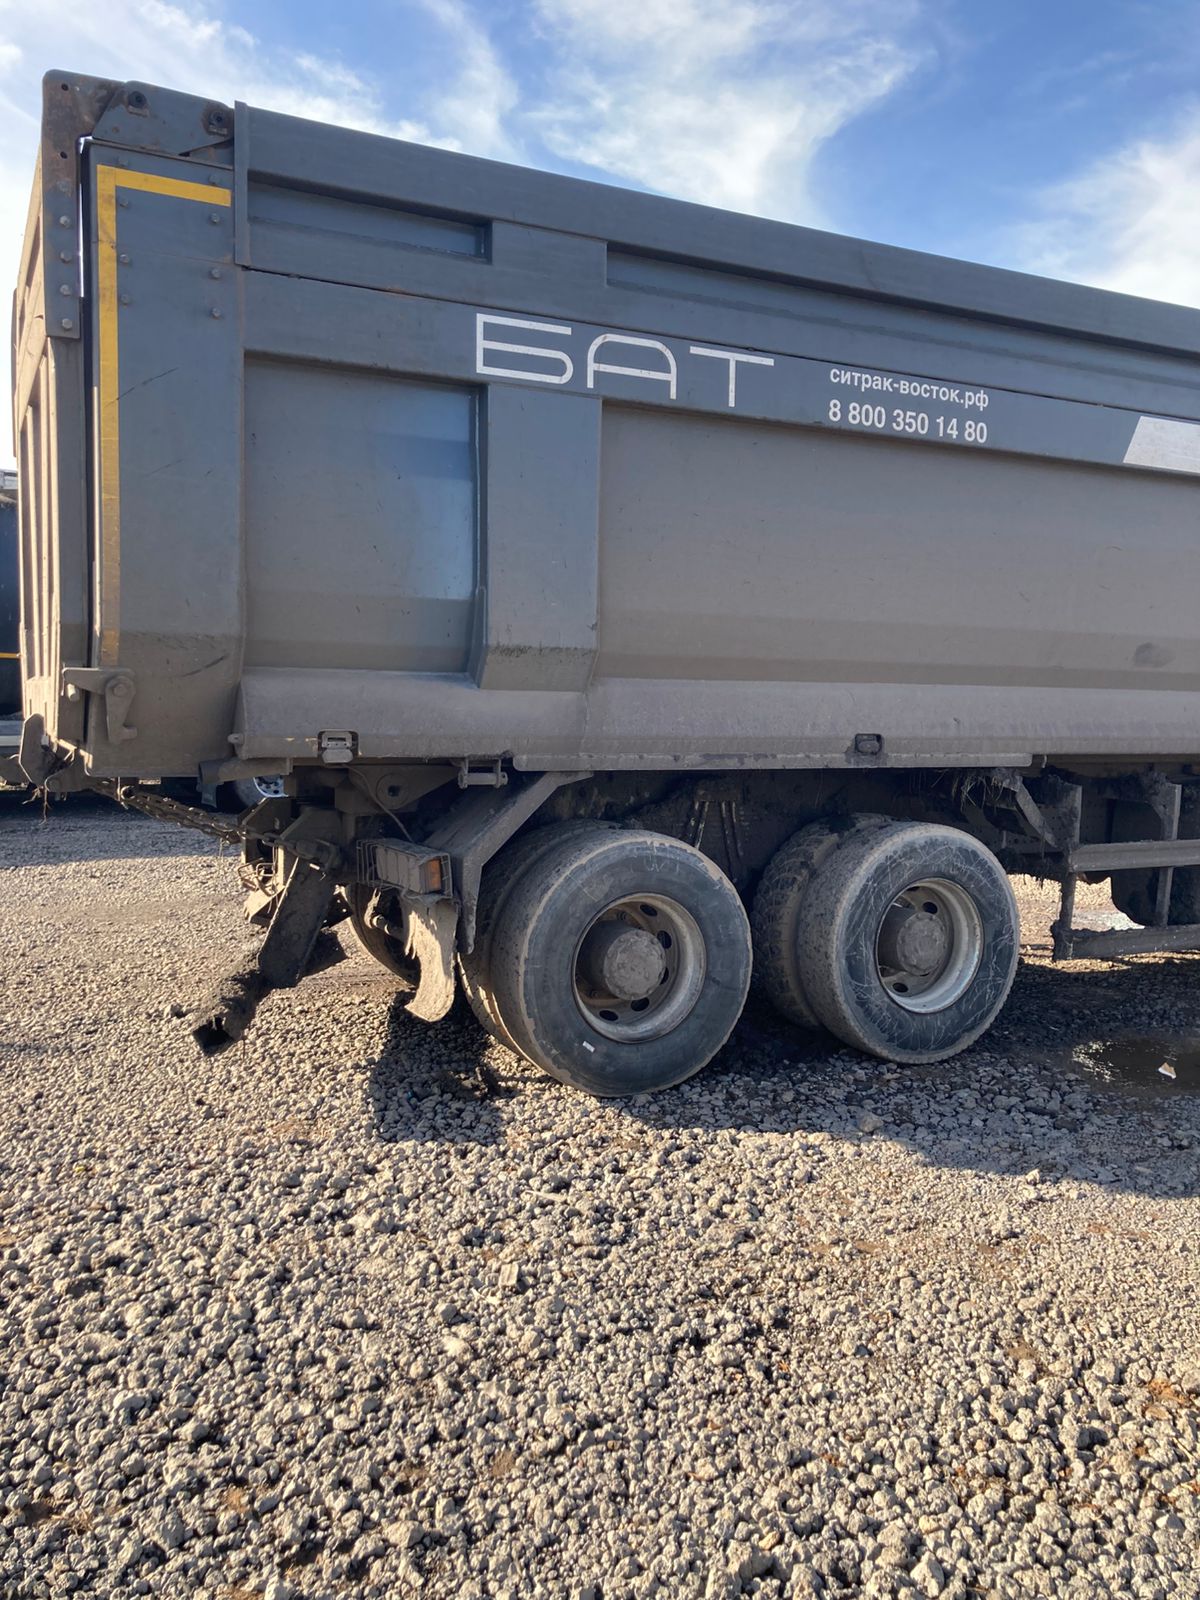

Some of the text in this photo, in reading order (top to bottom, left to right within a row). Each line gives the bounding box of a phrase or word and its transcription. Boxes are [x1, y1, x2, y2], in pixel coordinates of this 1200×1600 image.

[475, 313, 775, 408] БАТ
[829, 368, 989, 412] ситрак-восток.рф
[828, 399, 988, 444] 8 800 350 14 80
